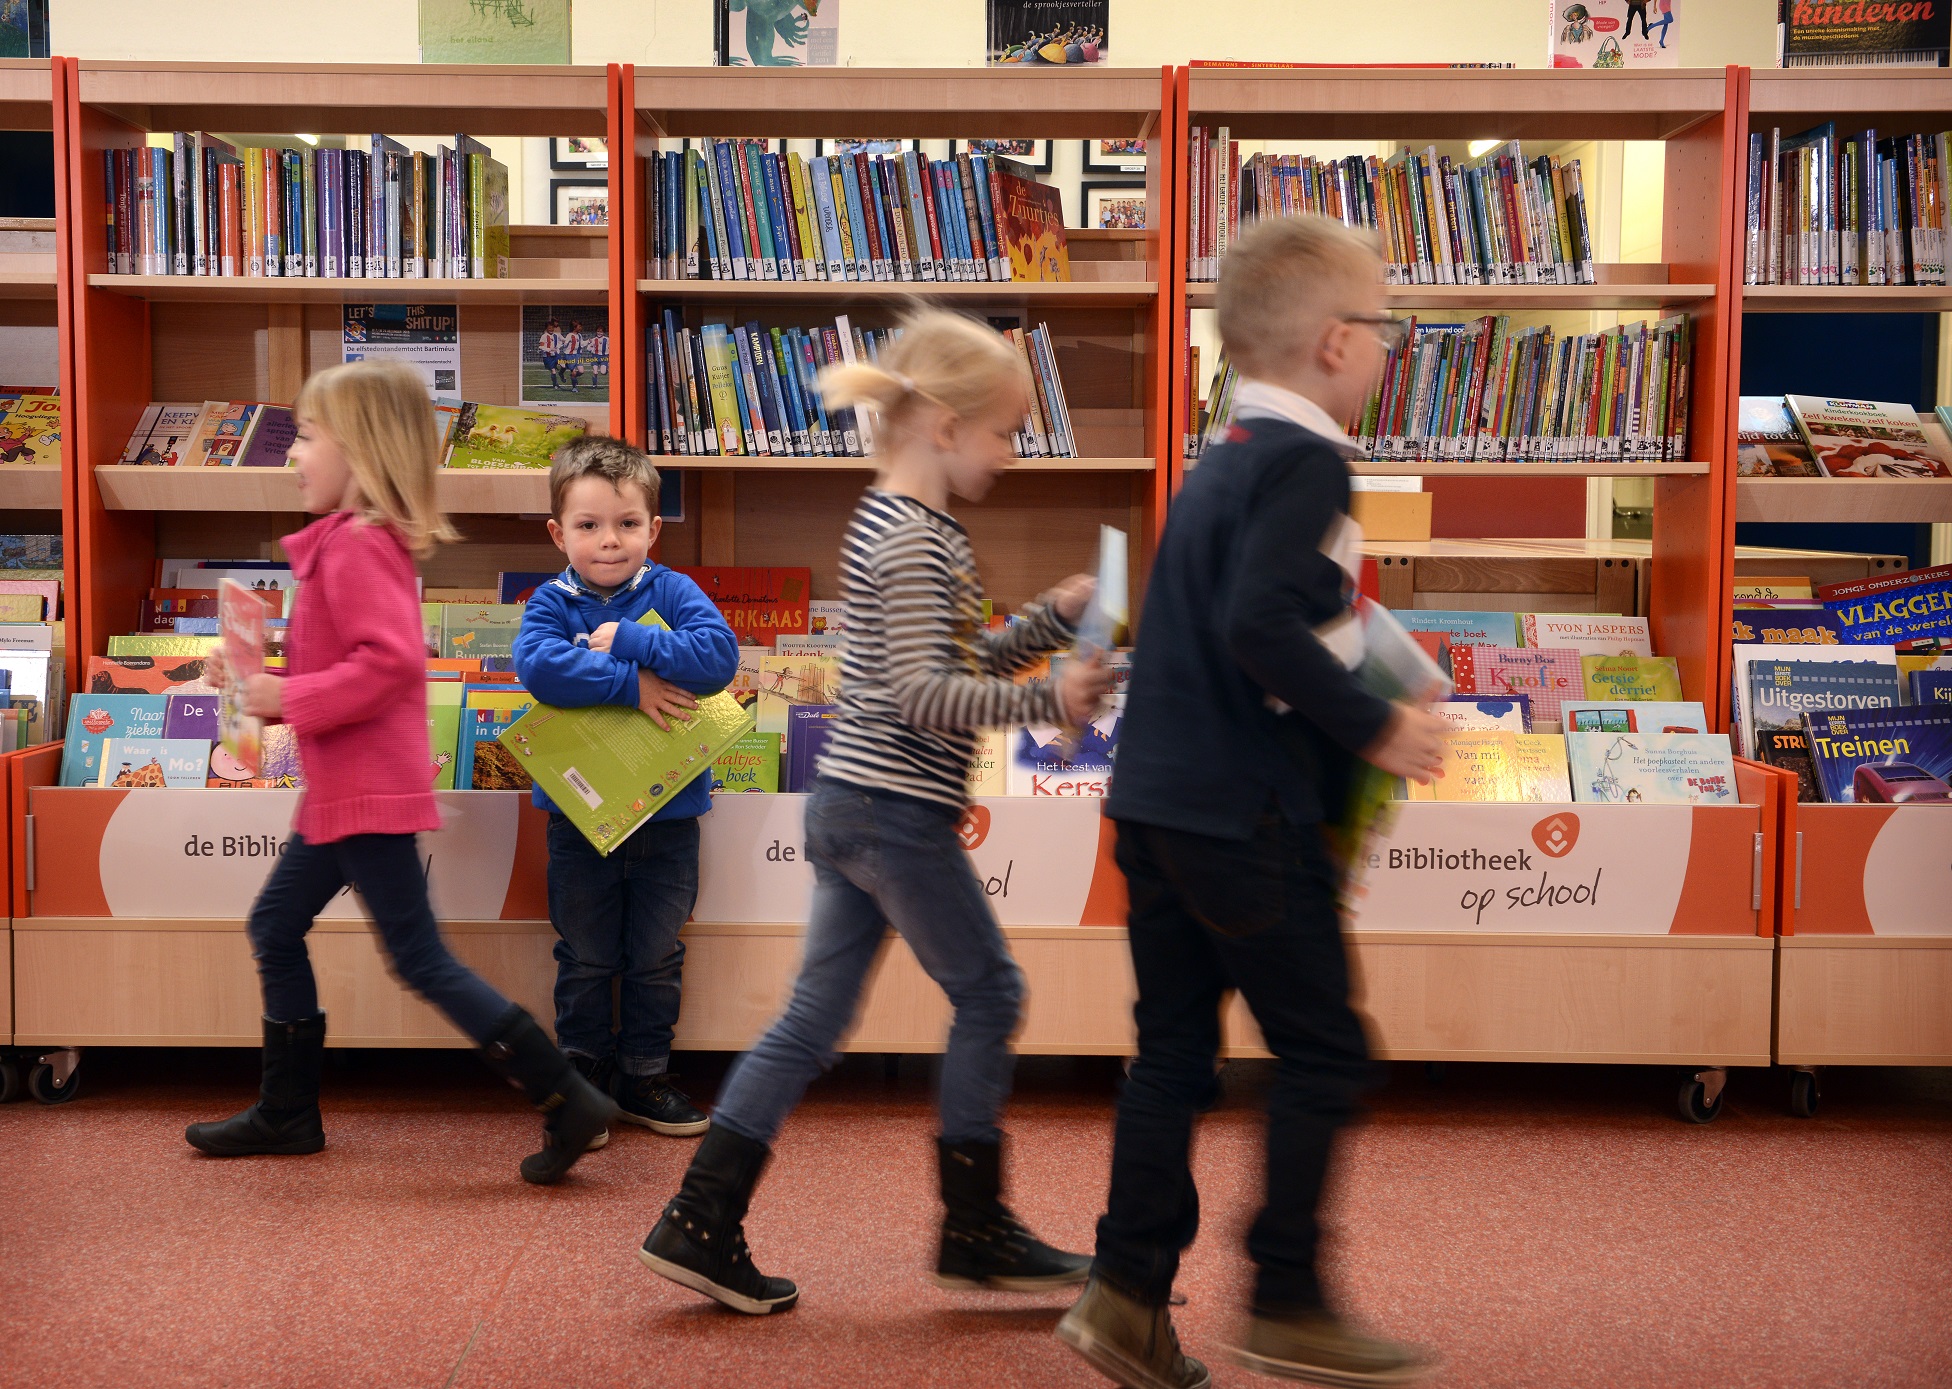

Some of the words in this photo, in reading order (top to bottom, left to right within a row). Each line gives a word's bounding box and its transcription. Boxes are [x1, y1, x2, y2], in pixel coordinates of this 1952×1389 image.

[1022, 0, 1032, 8] de
[1034, 0, 1103, 10] sprookjesverteller
[1792, 0, 1935, 26] kinderen
[1826, 26, 1866, 34] kennismaking
[1203, 60, 1239, 68] DEMATONS
[1016, 181, 1026, 196] de
[1009, 194, 1059, 227] Zuurtjes
[1448, 201, 1457, 232] piraten
[348, 306, 374, 319] LET'S
[406, 306, 425, 316] THIS
[406, 316, 432, 330] SHIT
[433, 316, 454, 332] UP!
[750, 332, 764, 366] KAMPIOEN
[577, 356, 585, 364] jij
[1827, 400, 1876, 410] KLUITMAN
[1824, 408, 1888, 418] Kinderkookboek
[1802, 412, 1821, 420] Zelf
[1822, 415, 1866, 424] kweken,
[1866, 417, 1885, 425] zelf
[1886, 419, 1919, 428] koken
[1738, 431, 1760, 441] tijd
[1763, 432, 1784, 440] tot
[263, 442, 292, 450] Jacque
[264, 448, 286, 456] Vrien
[1832, 584, 1866, 597] JONGE
[1868, 570, 1950, 590] ONDERZOEKERS
[707, 592, 741, 603] Charlotte
[154, 616, 175, 626] dag
[1438, 617, 1474, 626] Kromhout
[1463, 629, 1487, 638] boek
[1546, 623, 1584, 634] YVON
[1586, 623, 1645, 635] JASPERS
[1853, 630, 1880, 641] van
[1886, 624, 1902, 636] de
[1906, 615, 1952, 634] werel
[1761, 626, 1840, 645] maak
[1498, 653, 1532, 666] Burny
[1534, 655, 1556, 664] Bos
[1488, 666, 1569, 692] Knofje
[1591, 673, 1635, 684] Getsie
[1610, 683, 1658, 696] derrie!
[1759, 688, 1892, 712] Uitgestorven
[130, 707, 165, 721] Naar
[184, 704, 204, 716] De
[1438, 711, 1468, 722] Papa,
[476, 725, 488, 736] in
[1830, 728, 1849, 736] OVER
[123, 746, 150, 755] Waar
[160, 746, 168, 755] is
[1815, 735, 1910, 759] Treinen
[1456, 750, 1478, 760] Van
[1480, 749, 1501, 763] mij
[1646, 756, 1687, 766] poepkasteel
[1698, 758, 1725, 766] andere
[168, 758, 204, 772] Mo?
[1036, 761, 1058, 772] Het
[1061, 761, 1089, 772] feest
[1092, 764, 1112, 772] van
[1470, 764, 1485, 772] en
[1638, 766, 1700, 774] voorleesverhalen
[726, 766, 758, 784] boek
[184, 834, 214, 858] de
[766, 840, 796, 862] de
[1388, 848, 1532, 871] Bibliotheek
[1460, 888, 1496, 925] op
[1506, 868, 1602, 910] school
